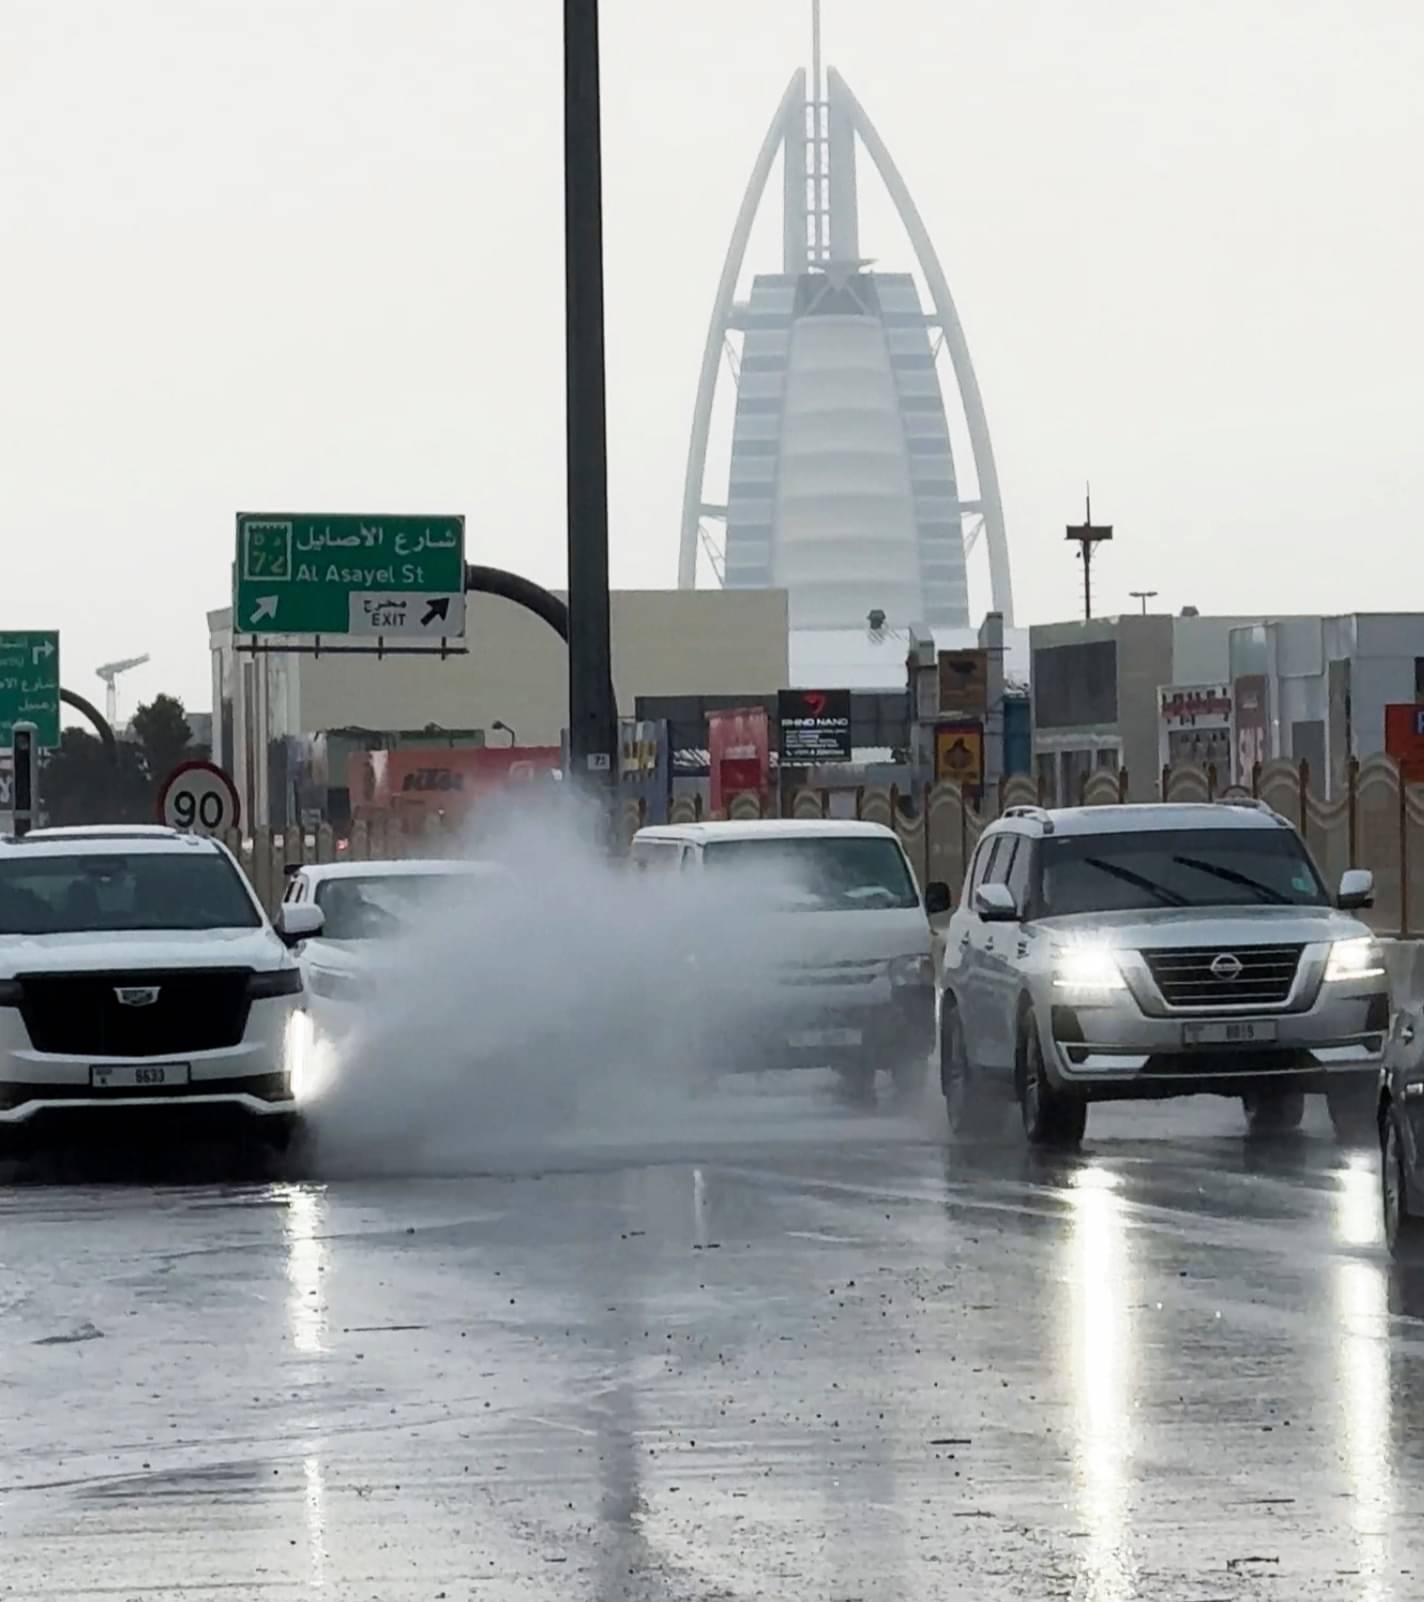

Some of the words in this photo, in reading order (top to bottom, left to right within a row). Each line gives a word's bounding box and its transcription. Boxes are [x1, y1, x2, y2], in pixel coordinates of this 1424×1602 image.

[394, 527, 457, 555] شارع
[296, 564, 319, 582] Al
[325, 564, 394, 587] Asayel
[402, 564, 425, 583] St
[371, 612, 406, 627] EXIT
[816, 718, 848, 727] NANO
[174, 790, 224, 829] 90
